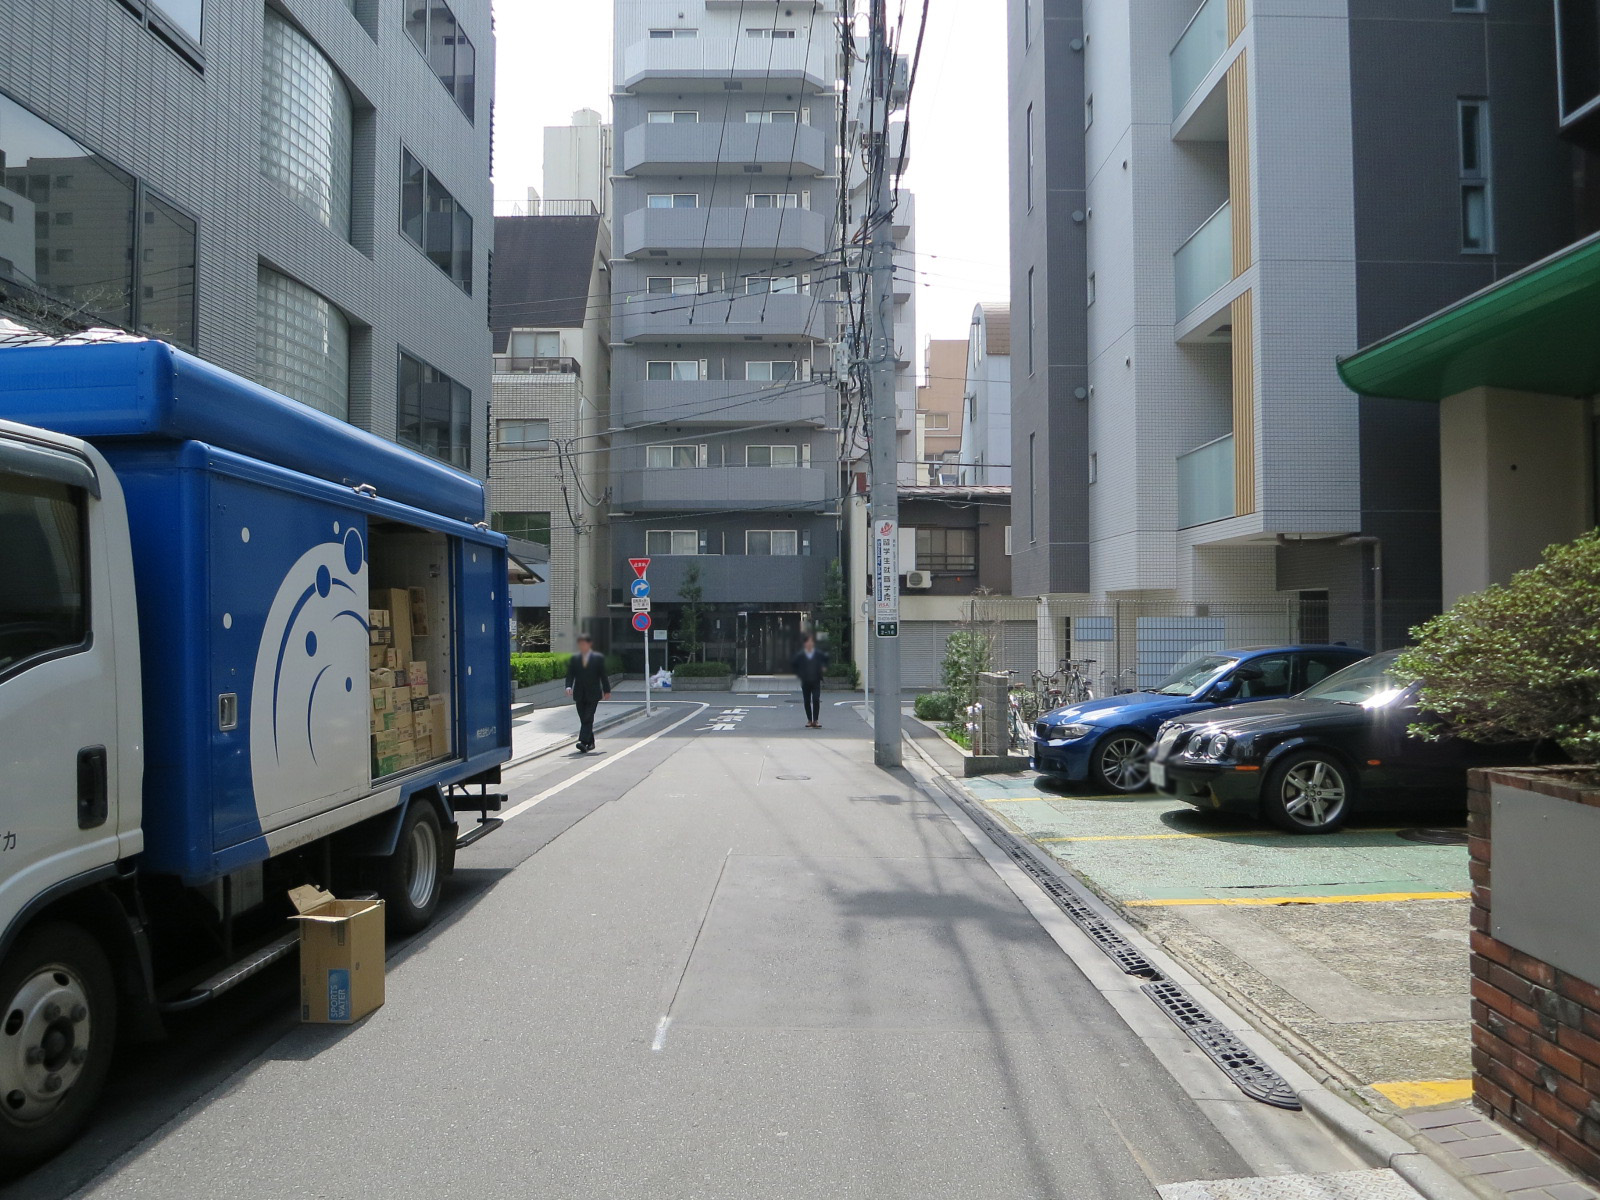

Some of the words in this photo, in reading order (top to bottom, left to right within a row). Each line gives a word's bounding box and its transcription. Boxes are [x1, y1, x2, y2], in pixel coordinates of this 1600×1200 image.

[0, 831, 17, 852] カ
[330, 984, 338, 1018] SPORTS
[338, 989, 346, 1018] WATER
